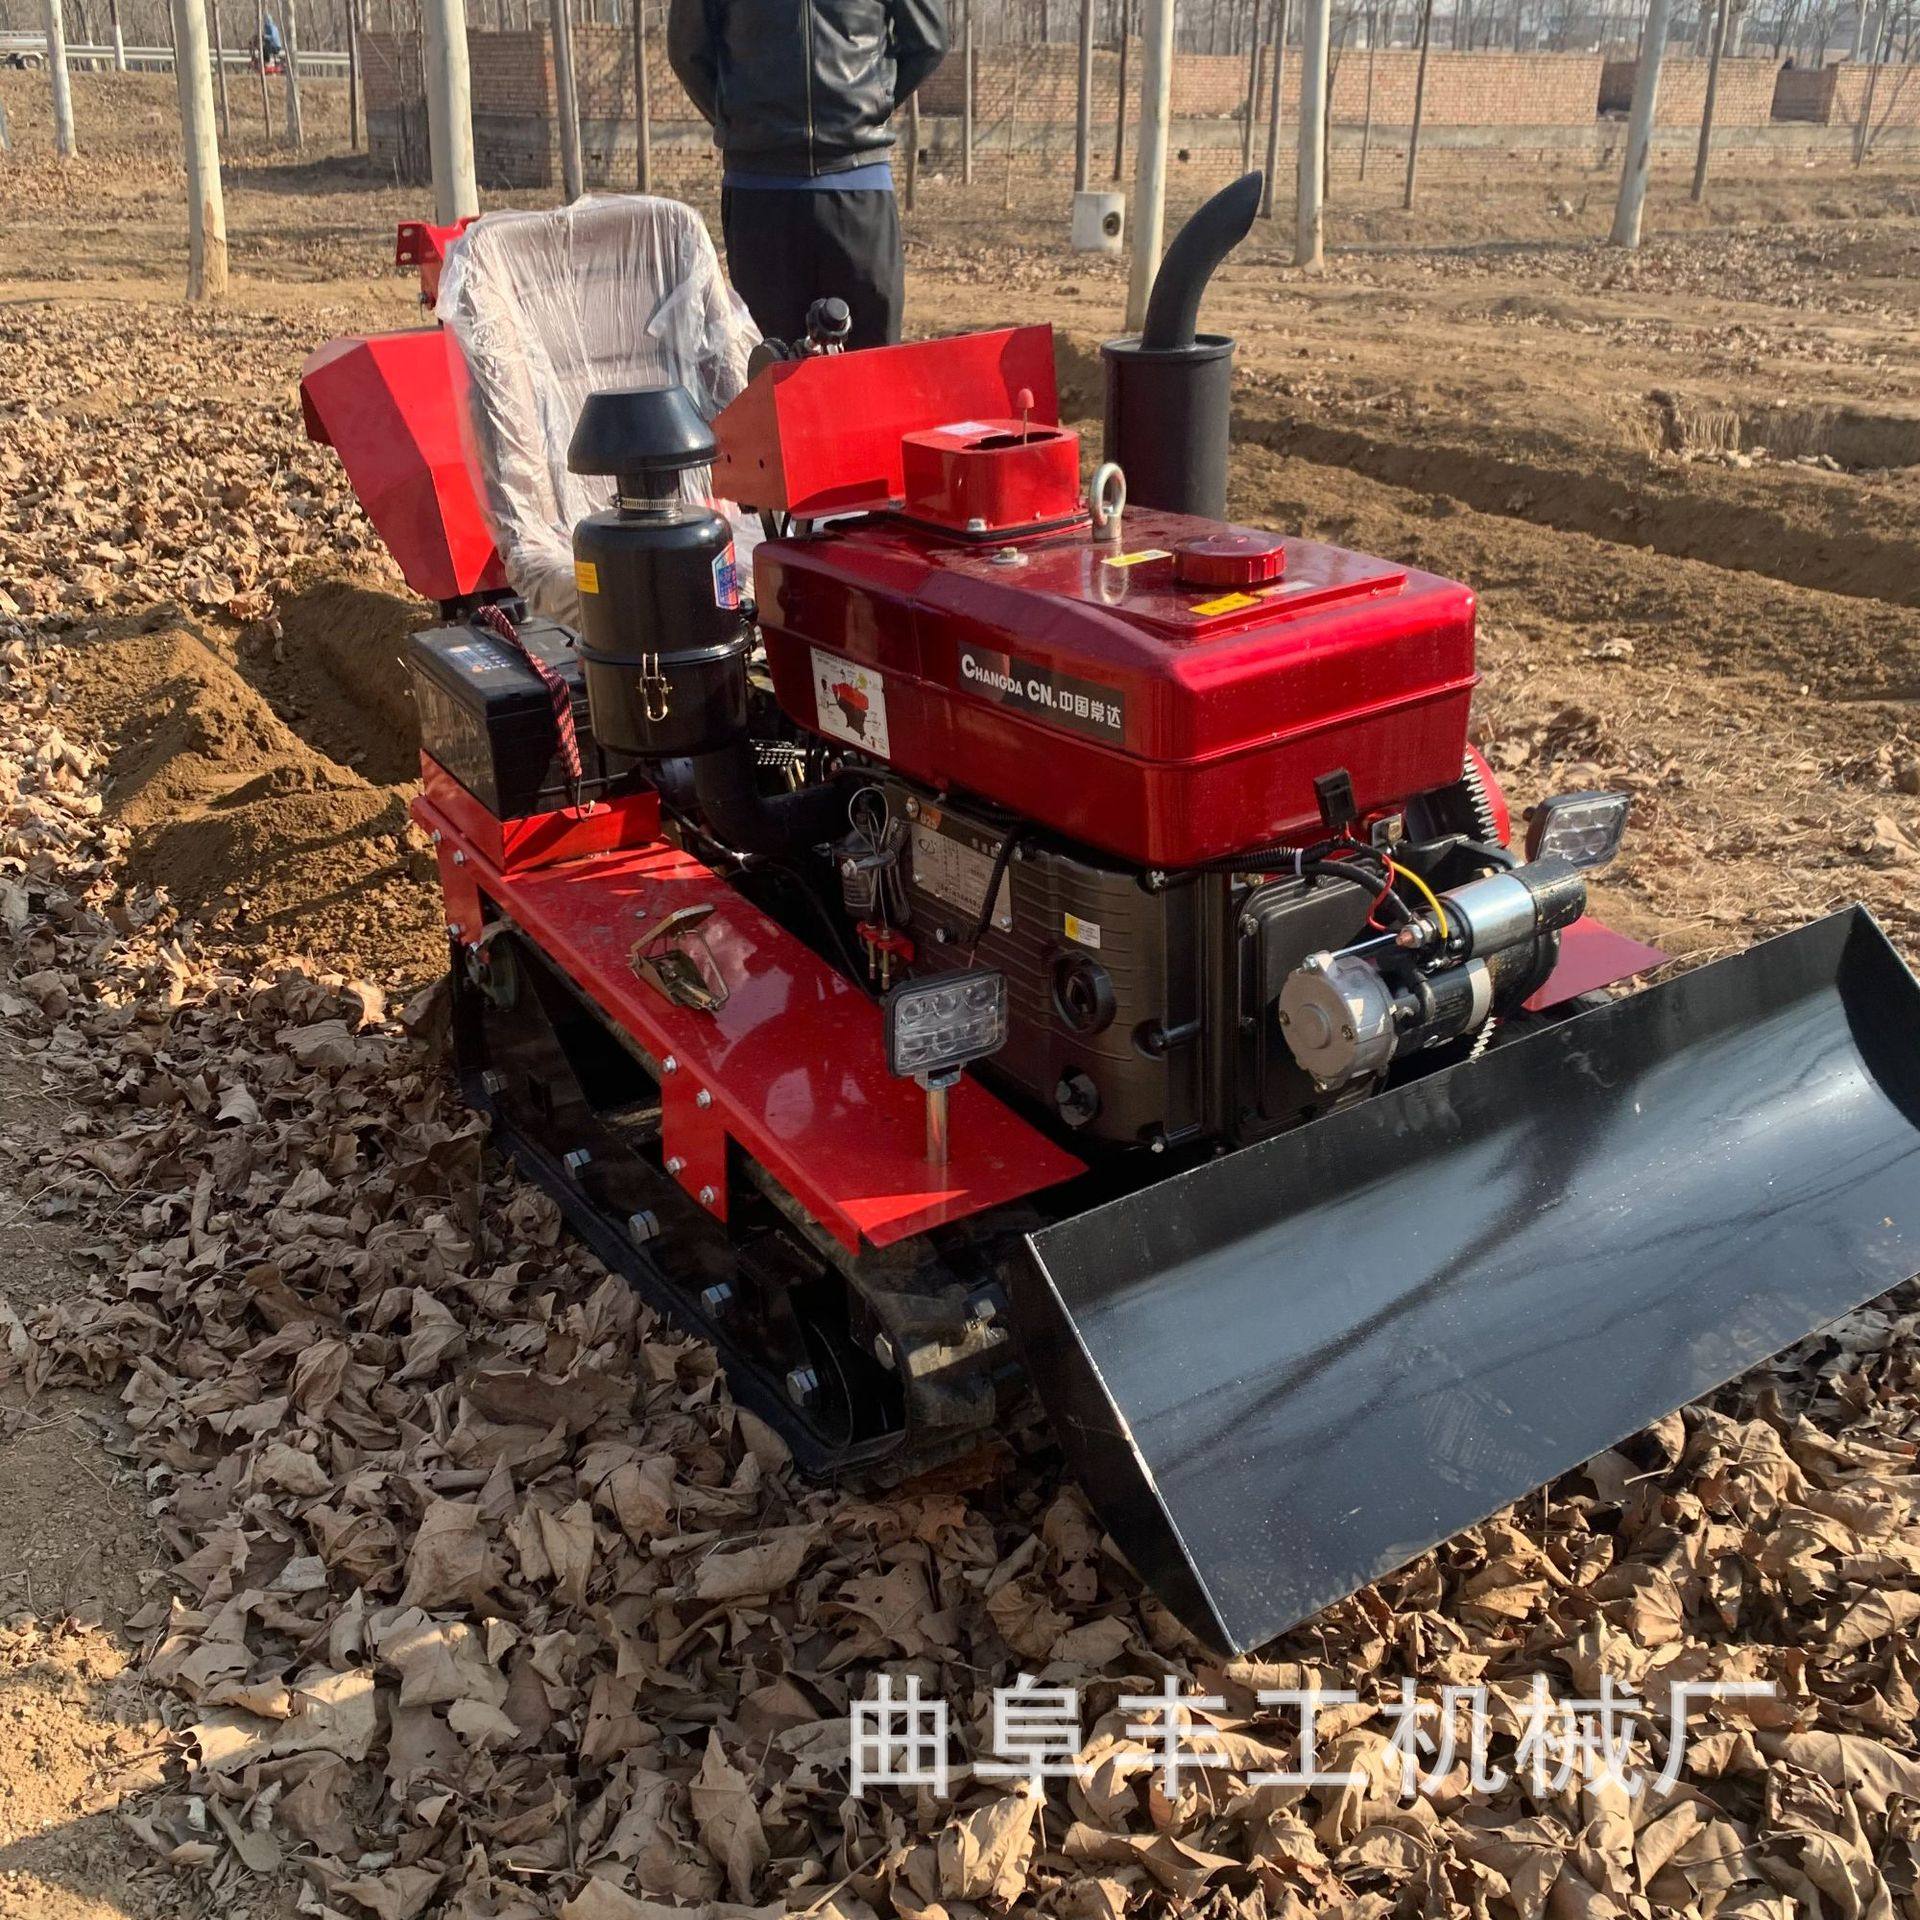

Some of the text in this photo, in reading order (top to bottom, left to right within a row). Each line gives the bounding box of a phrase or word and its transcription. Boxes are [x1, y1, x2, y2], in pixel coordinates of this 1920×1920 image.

[961, 654, 1023, 697] CHANGDA
[1059, 690, 1121, 729] 中国常达
